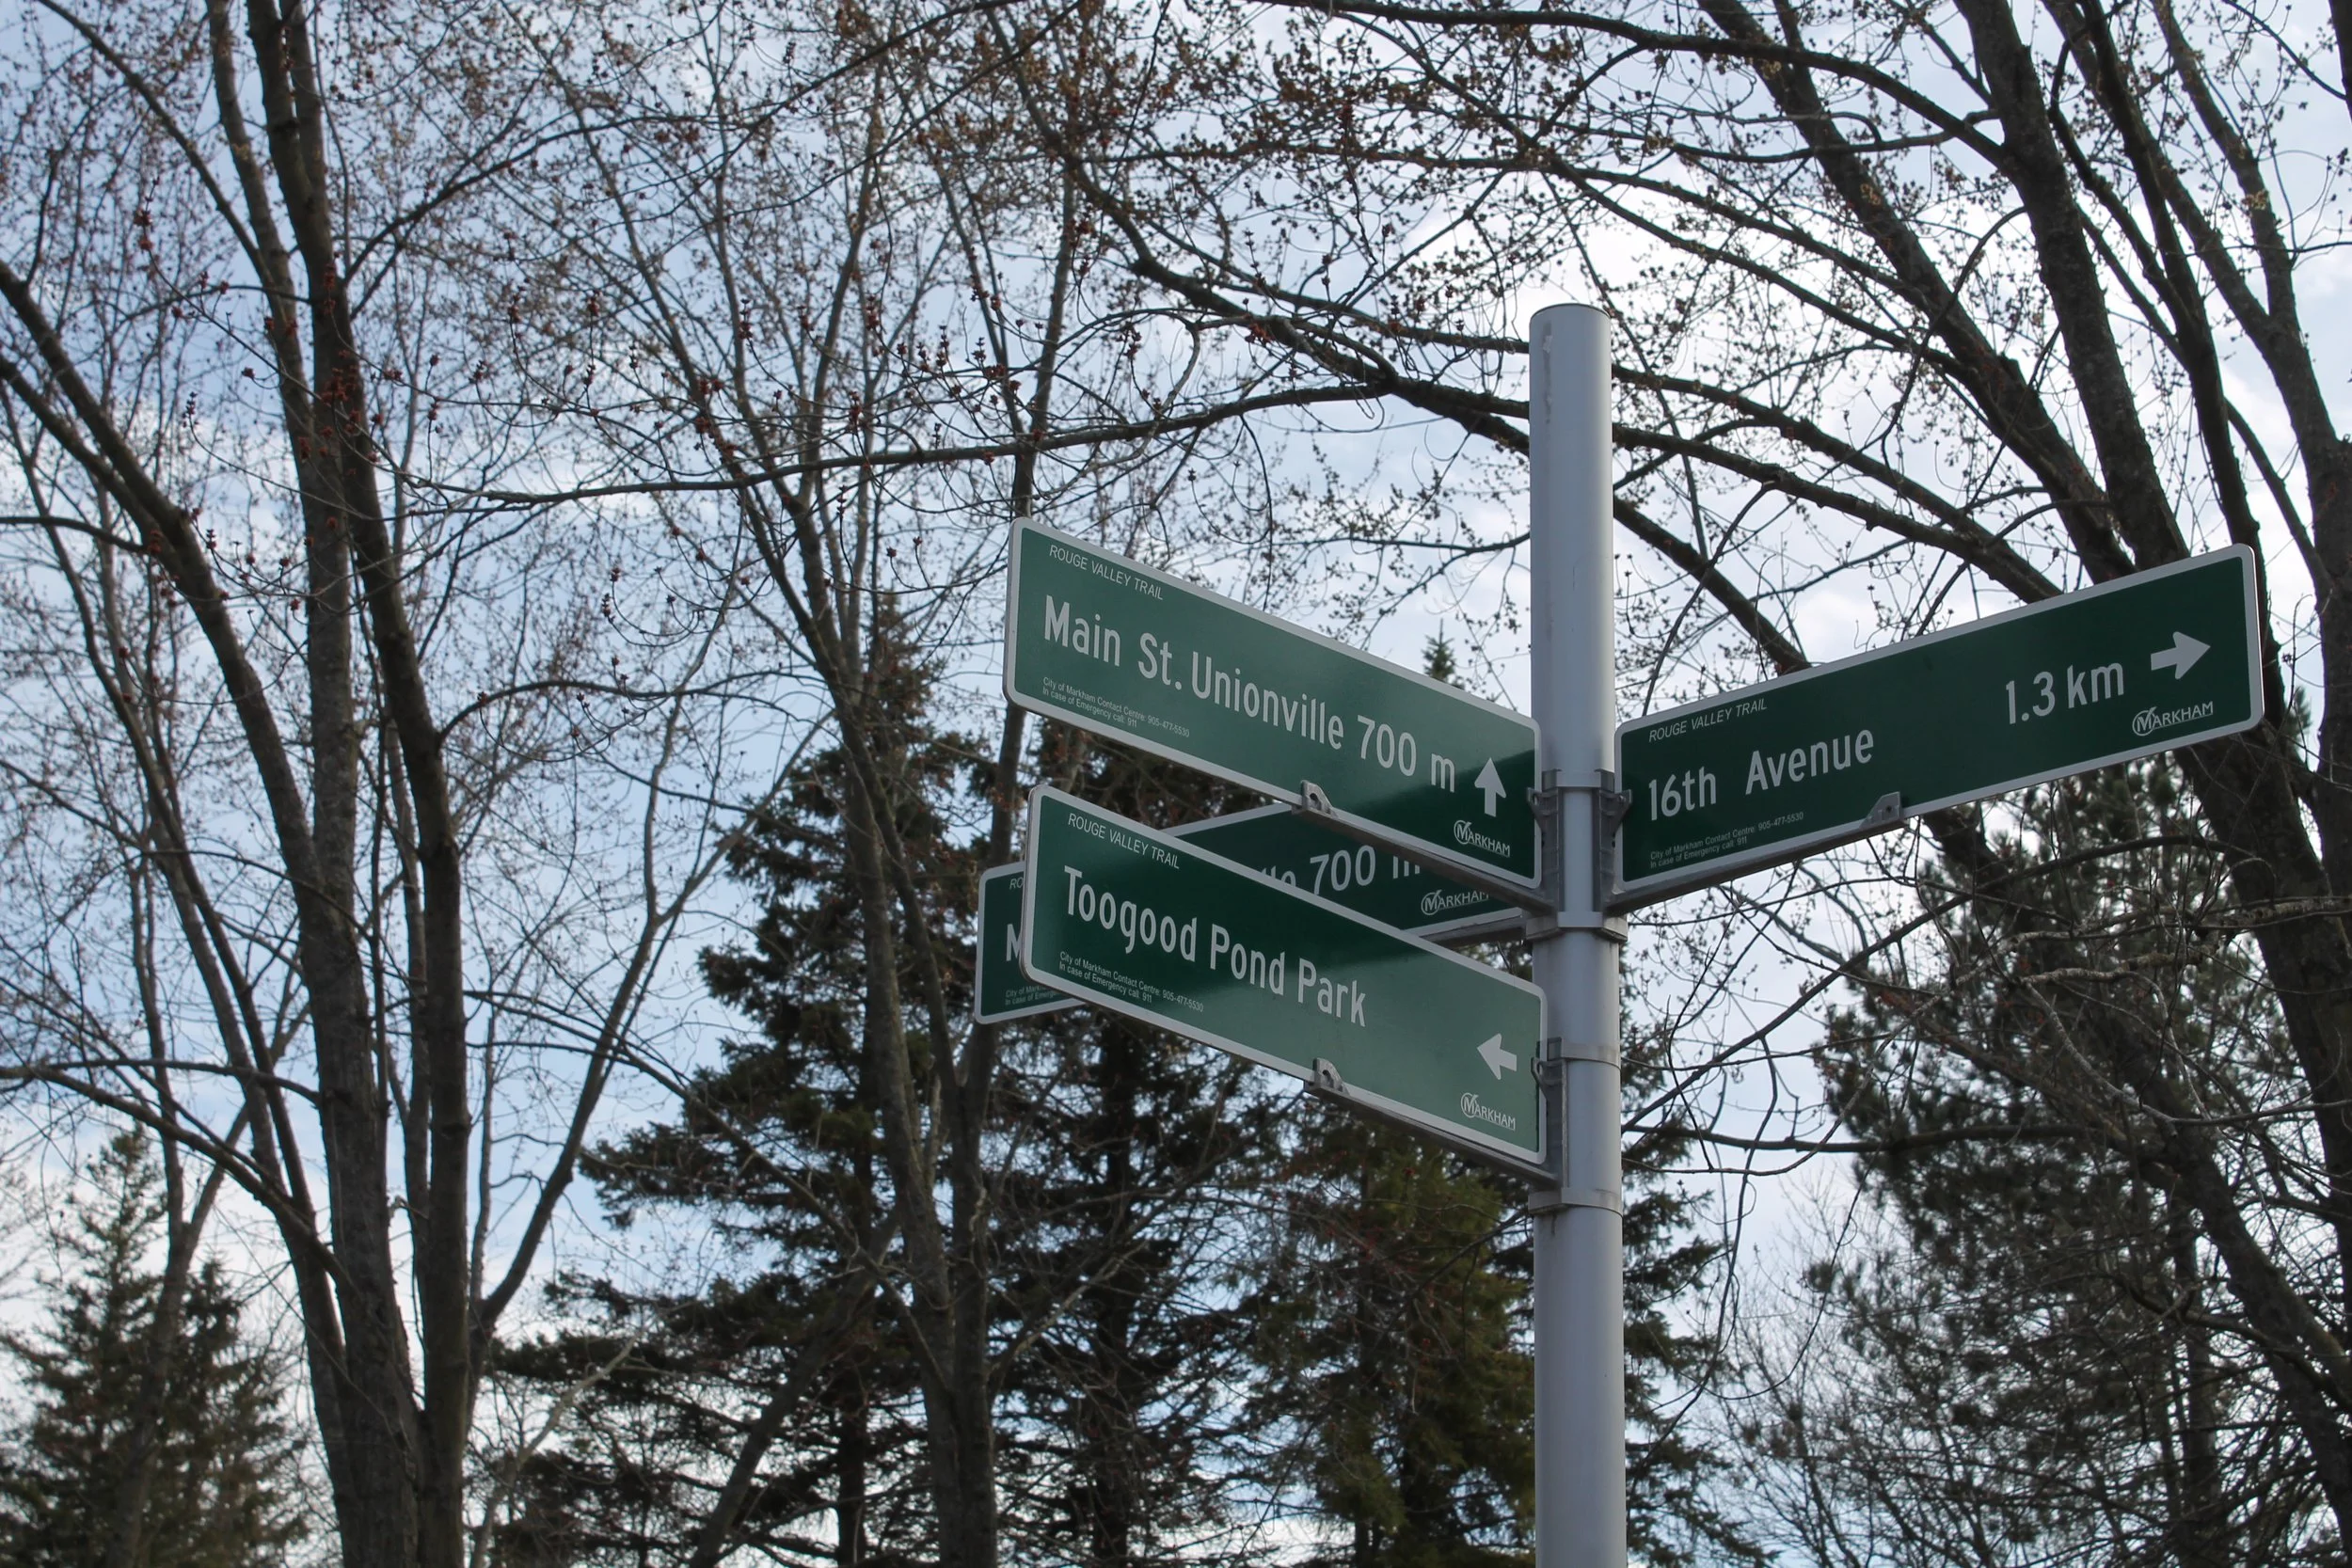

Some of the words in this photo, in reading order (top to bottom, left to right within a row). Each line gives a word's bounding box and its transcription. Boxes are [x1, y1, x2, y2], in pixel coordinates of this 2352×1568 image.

[1049, 545, 1089, 571] ROUGE
[1091, 560, 1132, 587] VALLEY
[1134, 578, 1164, 601] TRAIL
[1042, 676, 1057, 690] City
[1057, 682, 1065, 691] of
[1066, 685, 1096, 704] Markham
[1097, 696, 1123, 713] Contact
[1042, 687, 1049, 696] In
[1051, 690, 1067, 703] case
[1068, 695, 1075, 705] of
[1075, 698, 1112, 721] Emergency
[1127, 717, 1137, 728] 911
[1044, 594, 1120, 667] Main
[1137, 632, 1182, 690] St.
[1192, 651, 1344, 750] Unionville
[1358, 715, 1417, 777] 700
[1431, 753, 1455, 793] m
[1648, 721, 1687, 742] ROUGE
[1690, 707, 1733, 730] VALLEY
[1736, 698, 1768, 718] TRAIL
[2132, 701, 2214, 736] MARKHAM
[1648, 766, 1717, 821] 16th
[1745, 729, 1874, 795] Avenue
[2006, 671, 2056, 724] 1.3
[2067, 662, 2124, 709] km
[1068, 813, 1106, 839] ROUGE
[1109, 829, 1149, 855] VALLEY
[1151, 846, 1180, 869] TRAIL
[1454, 819, 1510, 858] MARKHAM
[1650, 849, 1663, 861] City
[1664, 847, 1673, 857] of
[1673, 839, 1704, 854] Markham
[1705, 832, 1731, 845] Contact
[1650, 860, 1657, 869] In
[1658, 856, 1674, 867] case
[1675, 852, 1683, 862] of
[1683, 844, 1721, 861] Emergency
[1737, 835, 1747, 847] 911
[1310, 845, 1376, 895] 700
[1064, 864, 1198, 962] Toogood
[1210, 923, 1285, 995] Pond
[1297, 957, 1366, 1027] Park
[1059, 951, 1073, 965] City
[1074, 957, 1082, 966] of
[1082, 958, 1112, 978] Markham
[1113, 971, 1137, 988] Contact
[1162, 990, 1204, 1013] 905-477-5530
[1059, 961, 1066, 971] In
[1067, 965, 1083, 977] case
[1084, 970, 1091, 980] of
[1092, 974, 1127, 996] Emergency
[1142, 991, 1152, 1003] 911
[1460, 1092, 1516, 1130] MARKHAM
